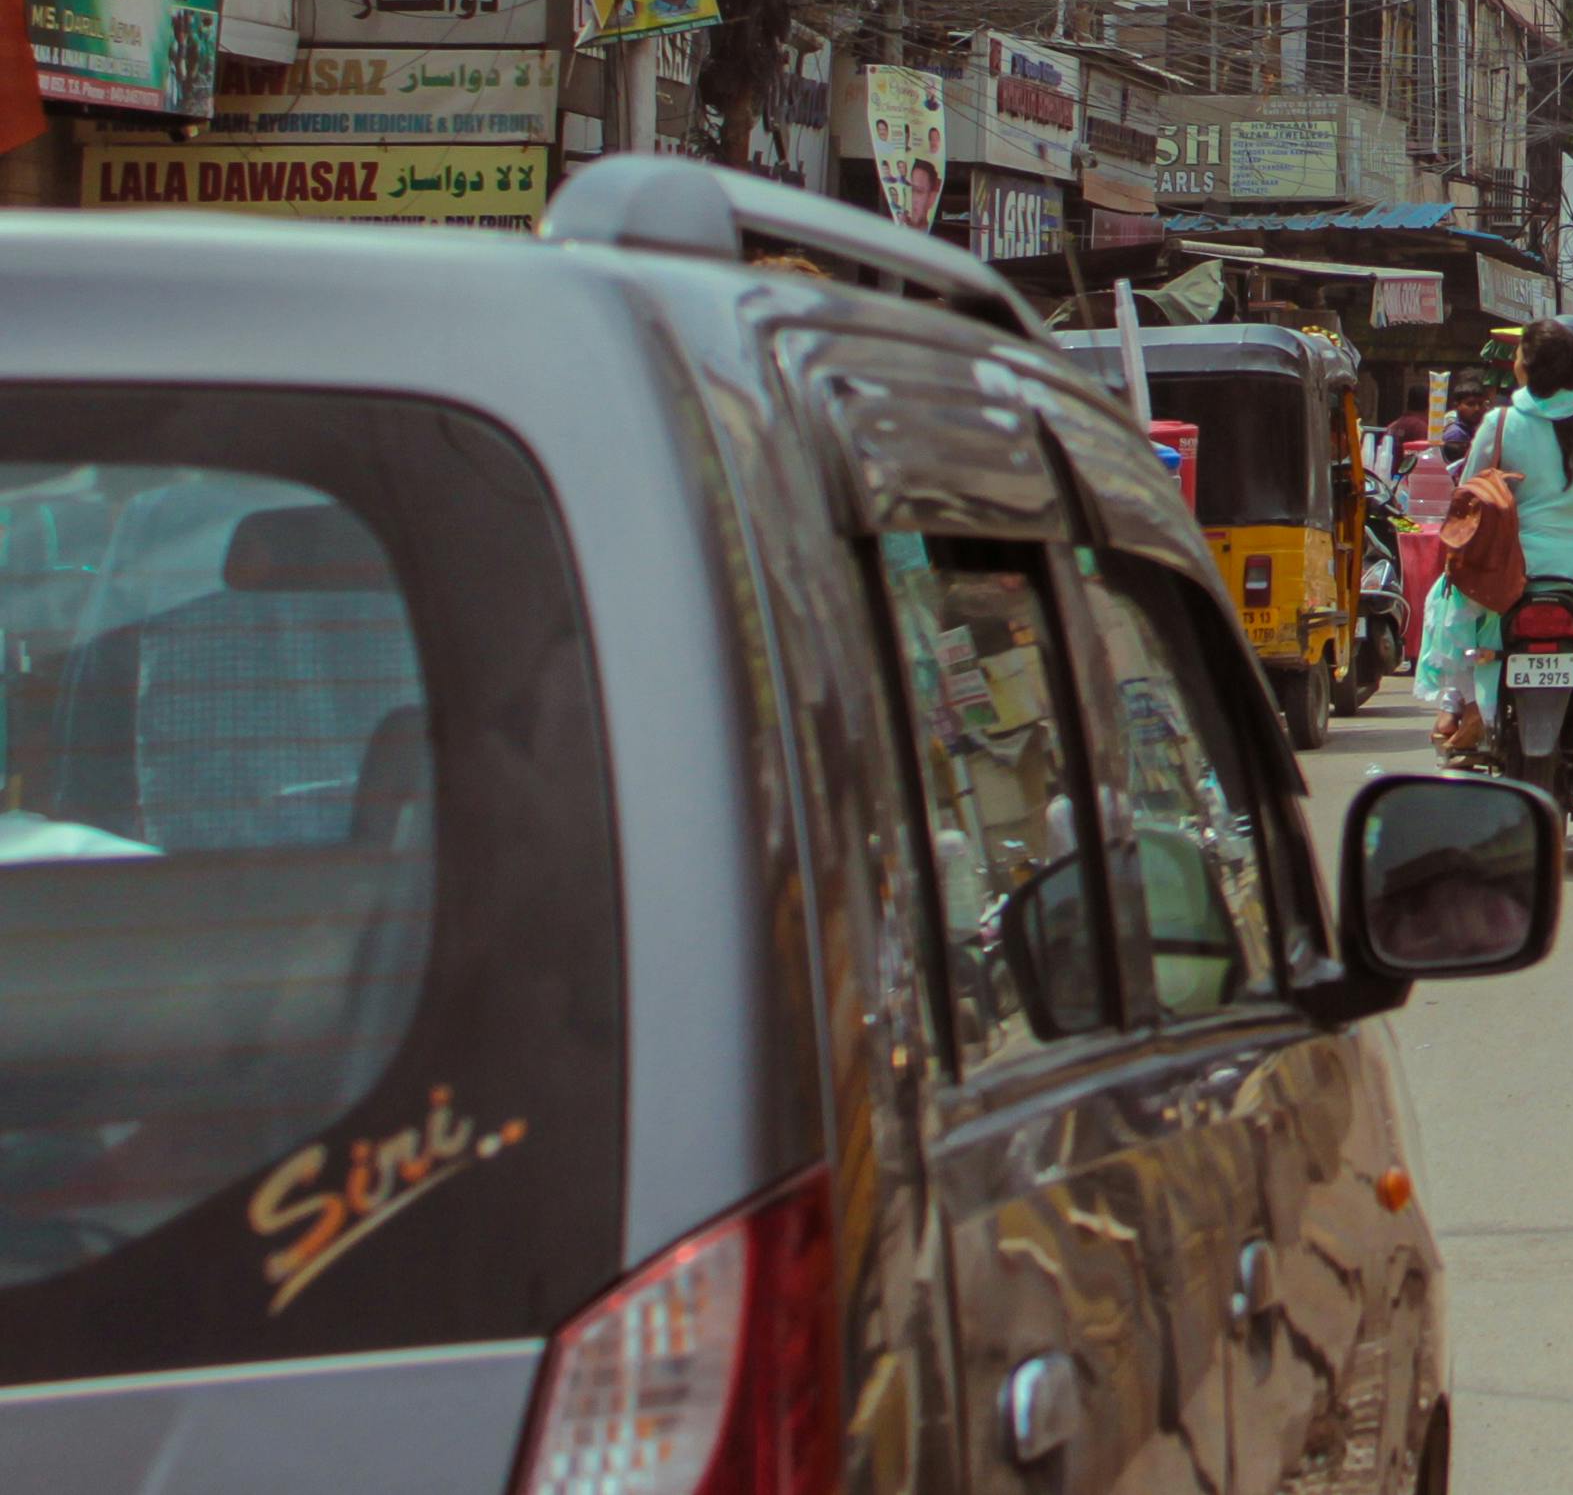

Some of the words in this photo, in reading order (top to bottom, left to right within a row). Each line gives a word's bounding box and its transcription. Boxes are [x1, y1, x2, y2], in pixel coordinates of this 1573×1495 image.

[218, 58, 387, 98] AWASAZ
[257, 112, 350, 135] AYURVEDIC
[354, 113, 435, 134] MEDICINE
[437, 115, 449, 134] &
[453, 114, 484, 134] DRY
[487, 112, 545, 134] FRUITS
[101, 161, 189, 203] LALA
[199, 161, 380, 202] DAWASAZ
[1154, 170, 1217, 194] ARLS
[994, 187, 1042, 261] LASSI
[1528, 657, 1559, 670] TS11
[1514, 672, 1530, 685] EA
[1538, 672, 1570, 685] 2975
